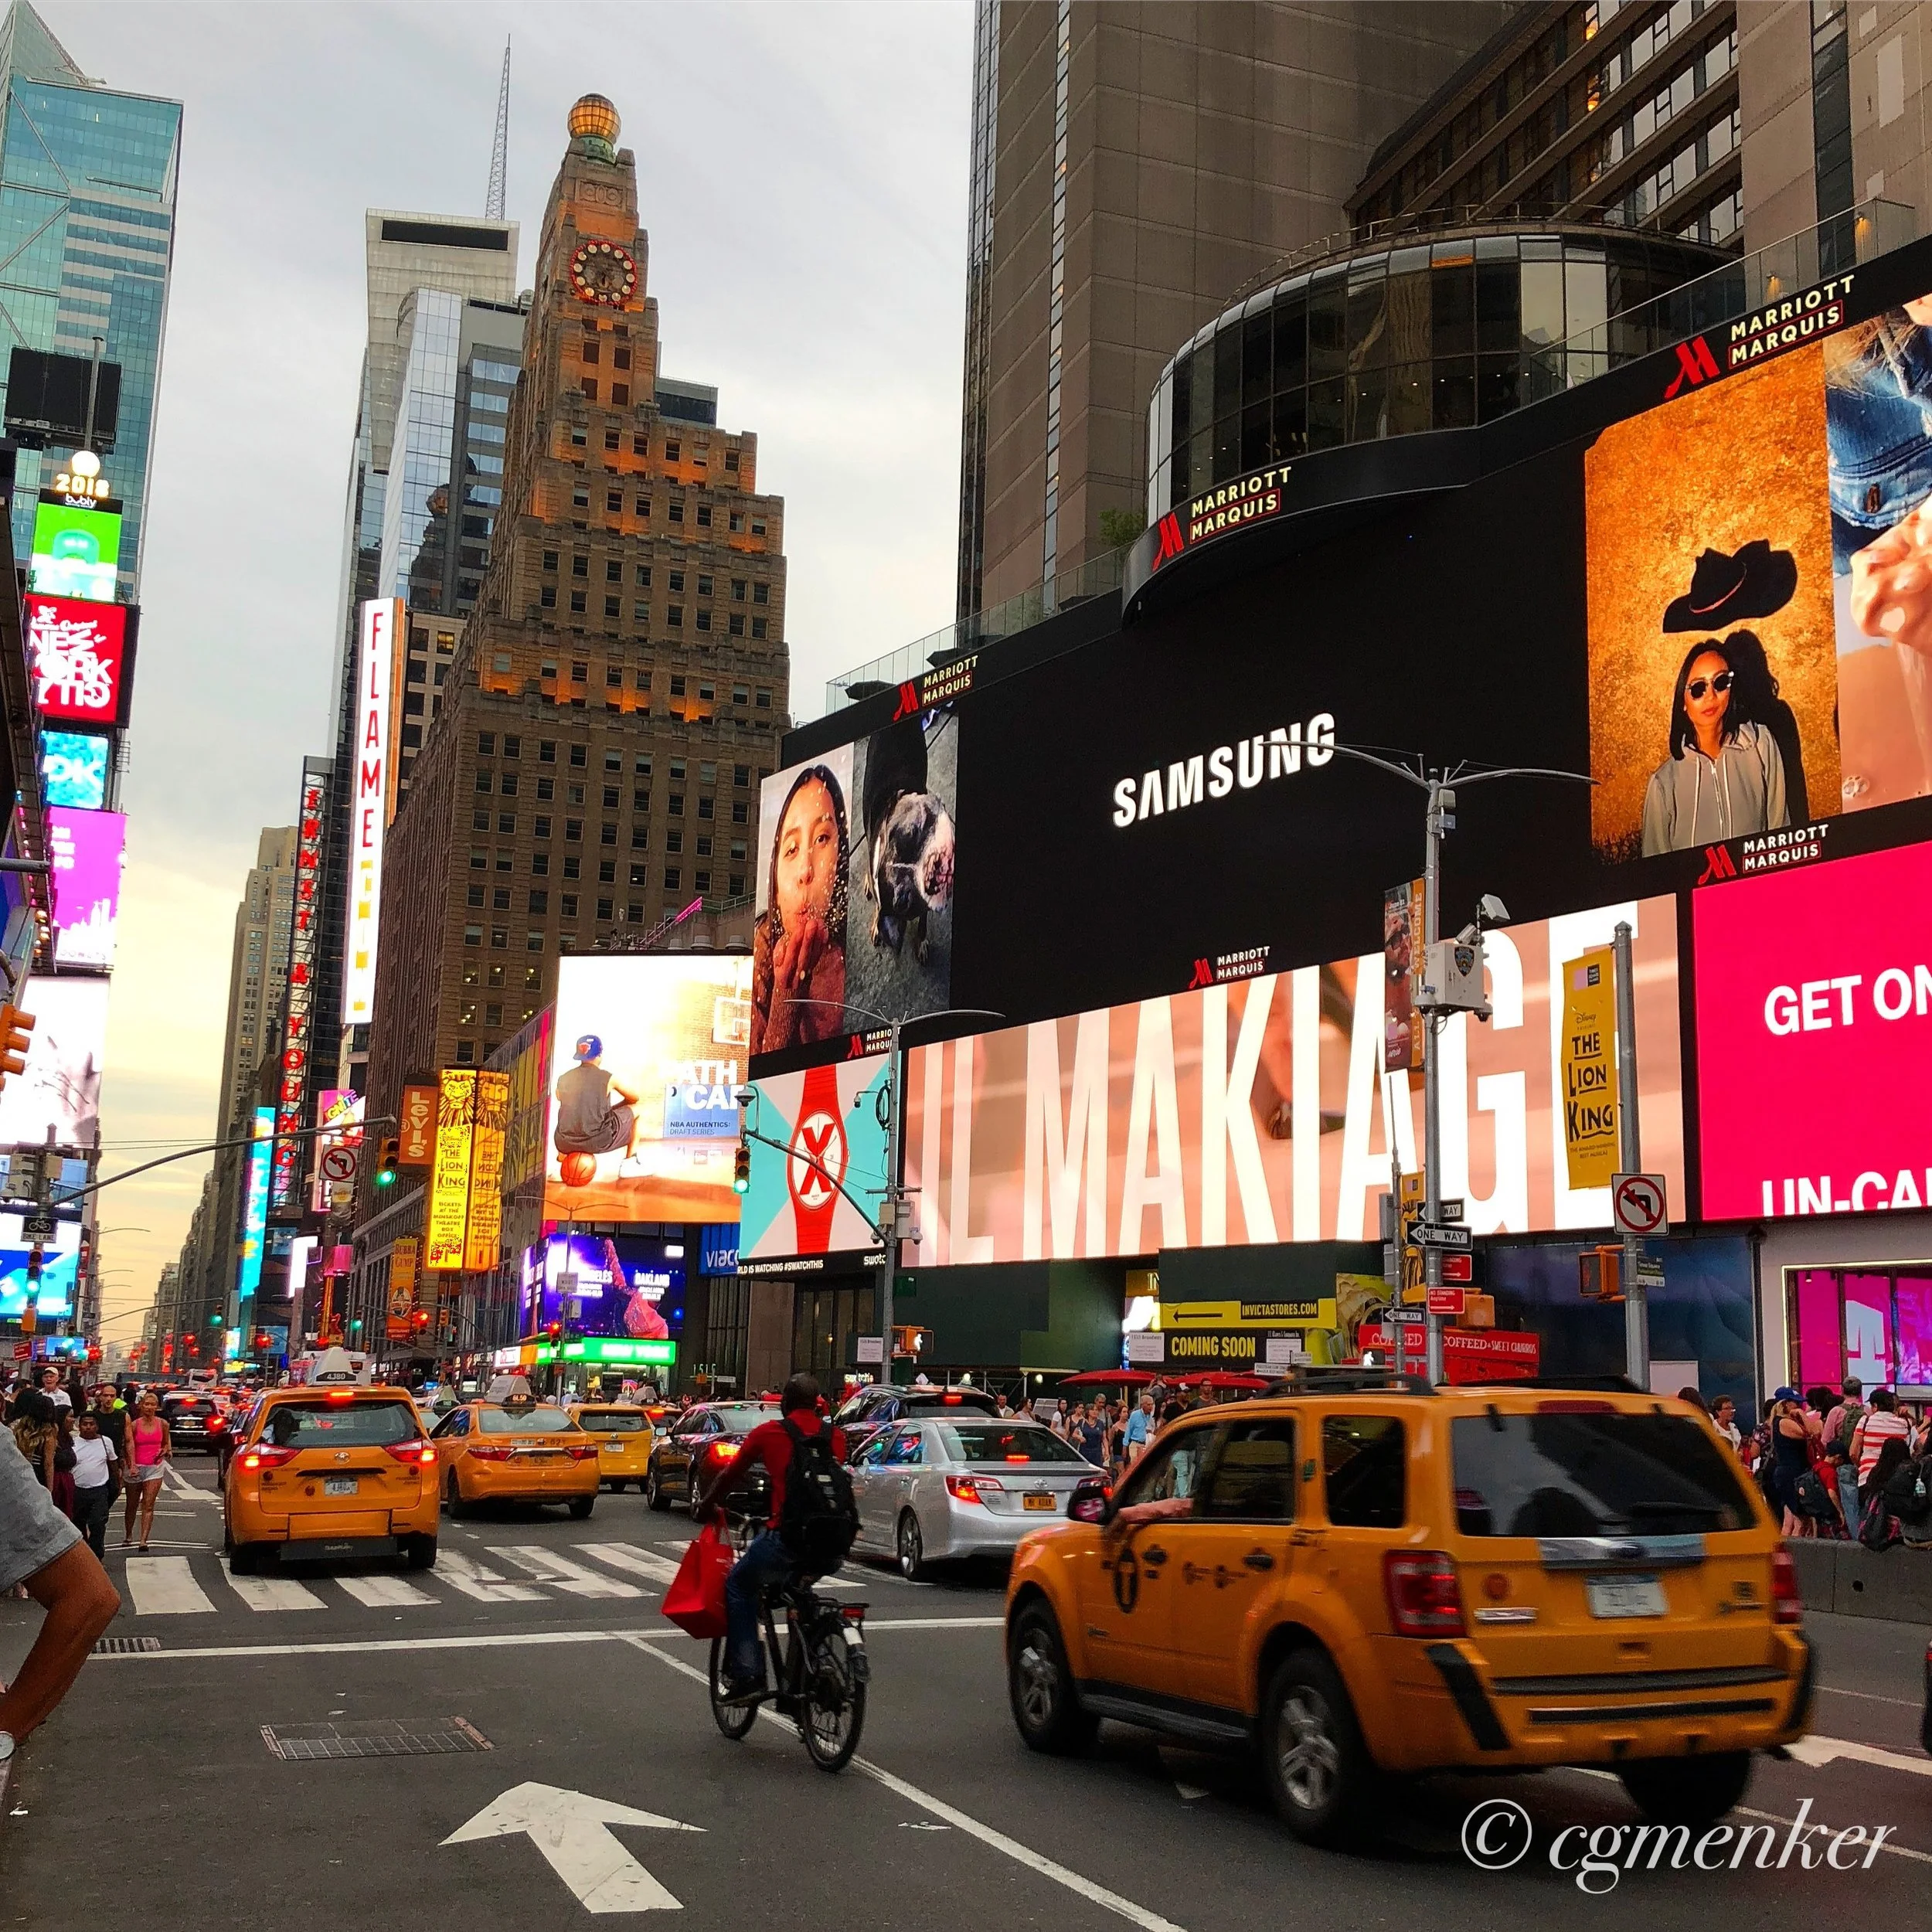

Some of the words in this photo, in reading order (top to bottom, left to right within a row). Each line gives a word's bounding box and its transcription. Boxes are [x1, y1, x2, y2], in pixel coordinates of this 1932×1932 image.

[1730, 274, 1855, 342] MARRIOTT
[1730, 306, 1840, 366] MARQUIS
[56, 473, 110, 498] 2018
[1191, 466, 1292, 519] MARRIOTT
[1191, 493, 1277, 540] MARQUIS
[923, 655, 979, 689] MARRIOTT
[923, 674, 971, 705] MARQUIS
[360, 611, 383, 849] FLAME
[1112, 713, 1335, 828] SAMSUNG
[1743, 823, 1830, 855] MARRIOTT
[1744, 843, 1819, 871] MARQUIS
[1413, 892, 1423, 971] WELCOME
[1217, 945, 1270, 967] MARRIOTT
[1217, 961, 1264, 980] MARQUIS
[1575, 1012, 1597, 1024] Disney
[1763, 974, 1862, 1036] GET
[866, 1026, 902, 1042] MARRIOT
[866, 1039, 893, 1052] MARQUI
[1571, 1031, 1601, 1056] THE
[275, 1015, 306, 1168] YOUNG
[920, 1039, 995, 1267] IL
[1022, 901, 1638, 1258] MAKIAGE
[1567, 1062, 1607, 1097] LION
[1566, 1100, 1614, 1143] KING
[440, 1158, 464, 1172] LION
[437, 1173, 466, 1189] KING
[1444, 1206, 1458, 1216] WAY
[1417, 1228, 1436, 1240] ONE
[1444, 1231, 1464, 1243] WAY
[748, 1264, 755, 1274] IS
[754, 1262, 784, 1274] WATCHING
[784, 1259, 824, 1272] #SWATCHTHIS
[863, 1253, 887, 1267] swatc
[1242, 1303, 1318, 1316] INVICTASTORES.COM
[1172, 1335, 1219, 1357] COMING
[1221, 1336, 1257, 1358] SOON
[1371, 1332, 1423, 1346] COED
